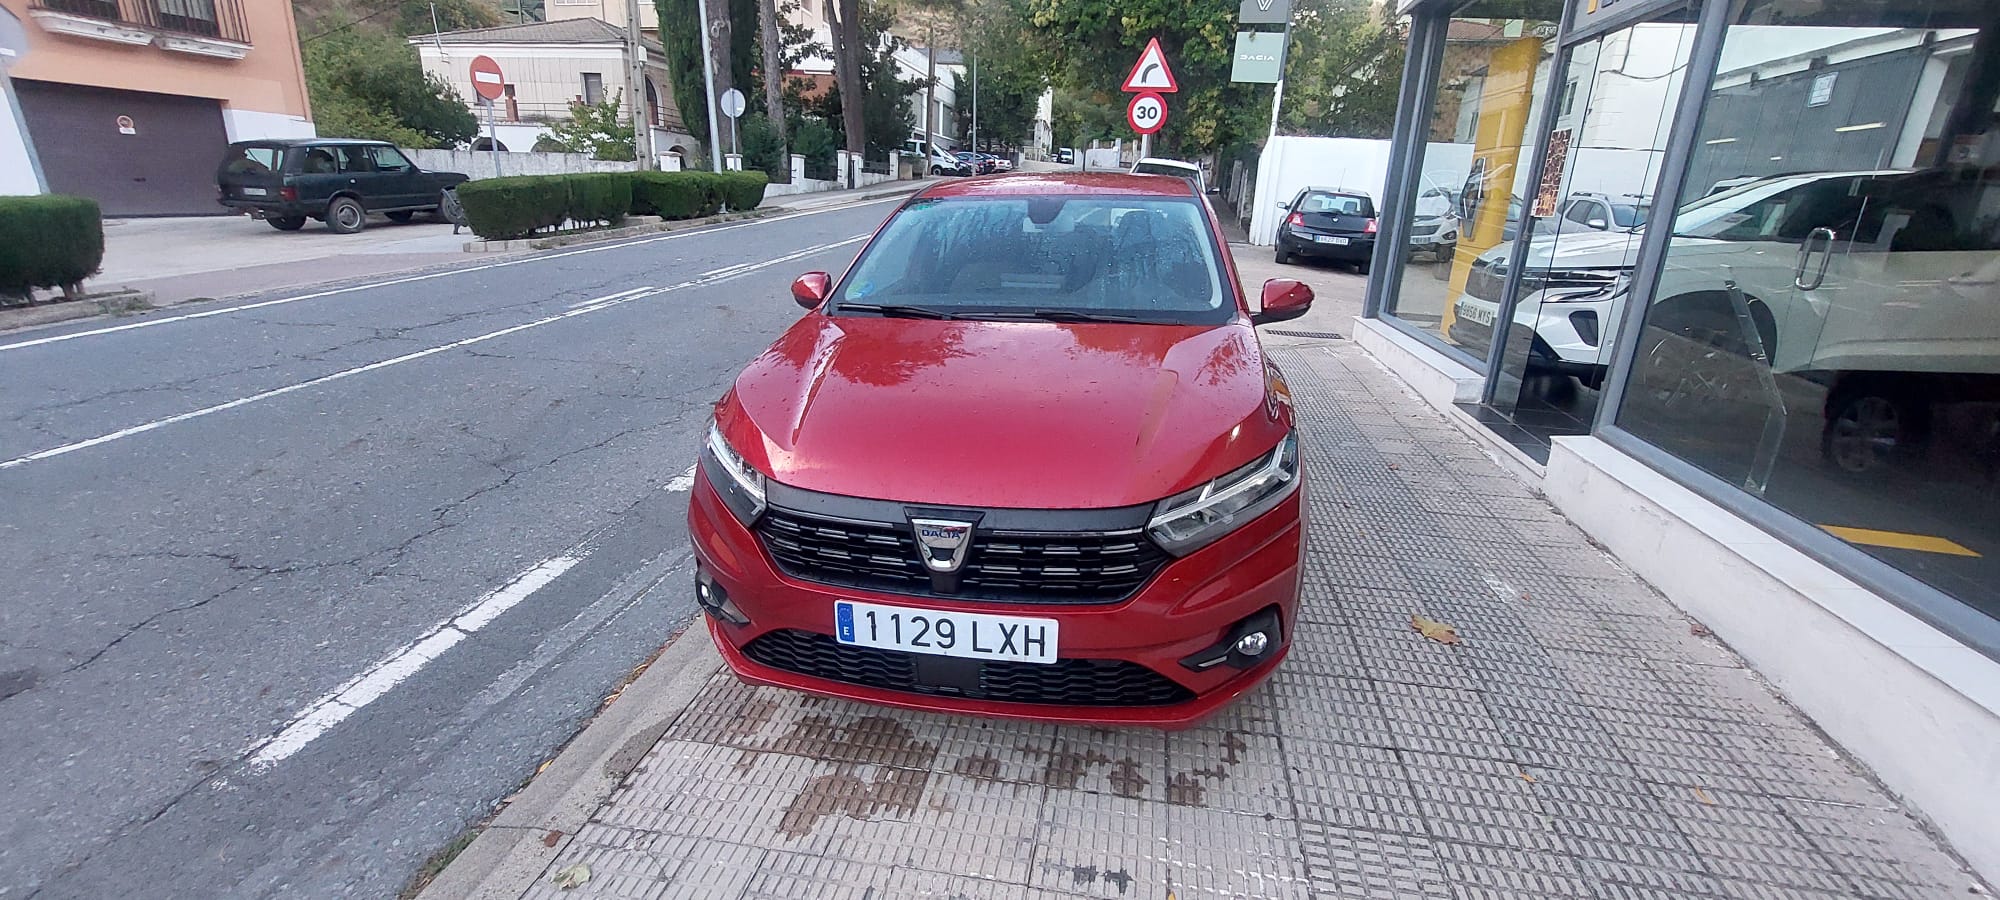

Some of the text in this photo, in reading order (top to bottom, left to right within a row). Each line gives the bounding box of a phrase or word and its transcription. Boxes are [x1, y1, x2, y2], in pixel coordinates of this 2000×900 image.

[1136, 106, 1158, 119] 30
[922, 529, 960, 539] DACIA
[843, 626, 850, 636] E
[866, 611, 1046, 656] 1129 LXH
